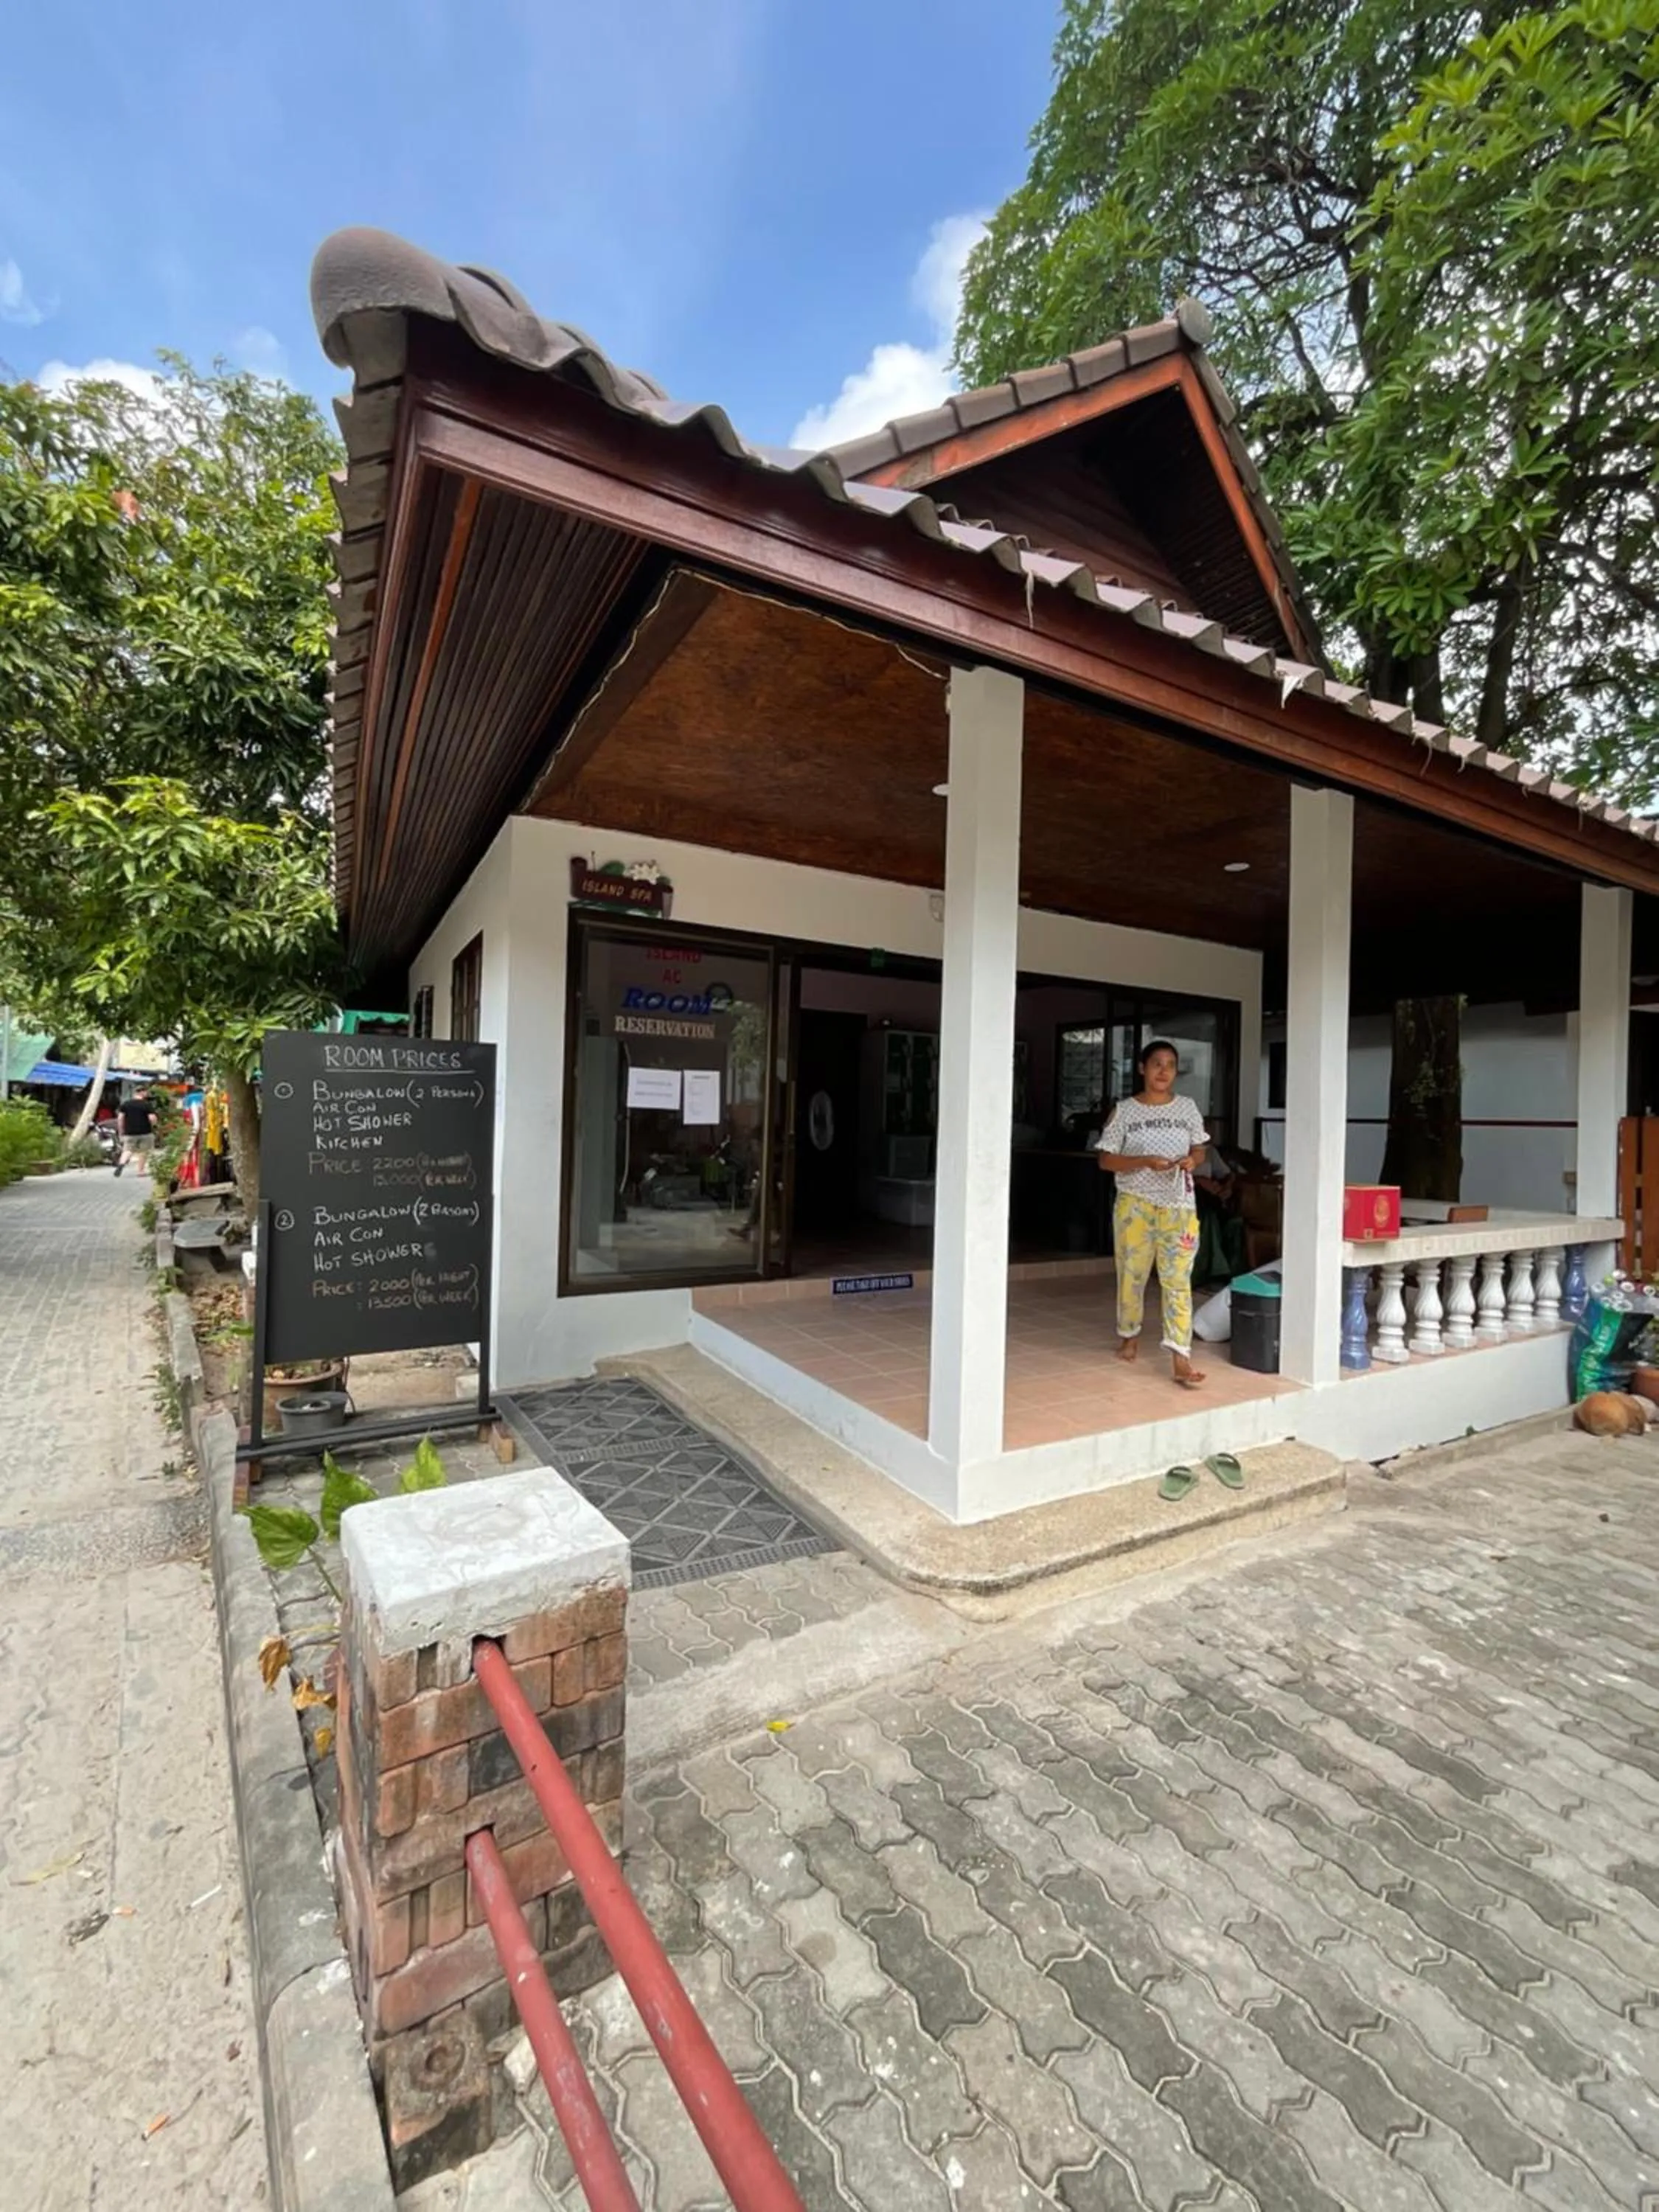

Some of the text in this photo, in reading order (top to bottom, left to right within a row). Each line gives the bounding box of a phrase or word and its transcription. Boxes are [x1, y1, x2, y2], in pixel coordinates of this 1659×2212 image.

[582, 880, 652, 902] ISLAND SPA
[621, 987, 712, 1015] ROOM
[614, 1015, 715, 1039] RESERVATION
[324, 1045, 462, 1068] ROOM PRICES
[313, 1100, 339, 1113] AIR
[313, 1113, 411, 1132] HOT SHOWER
[316, 1135, 383, 1150] KITCHEN
[308, 1152, 361, 1175] PRICE
[314, 1227, 383, 1246] AIR CON
[313, 1243, 422, 1273] HOT SHOWER
